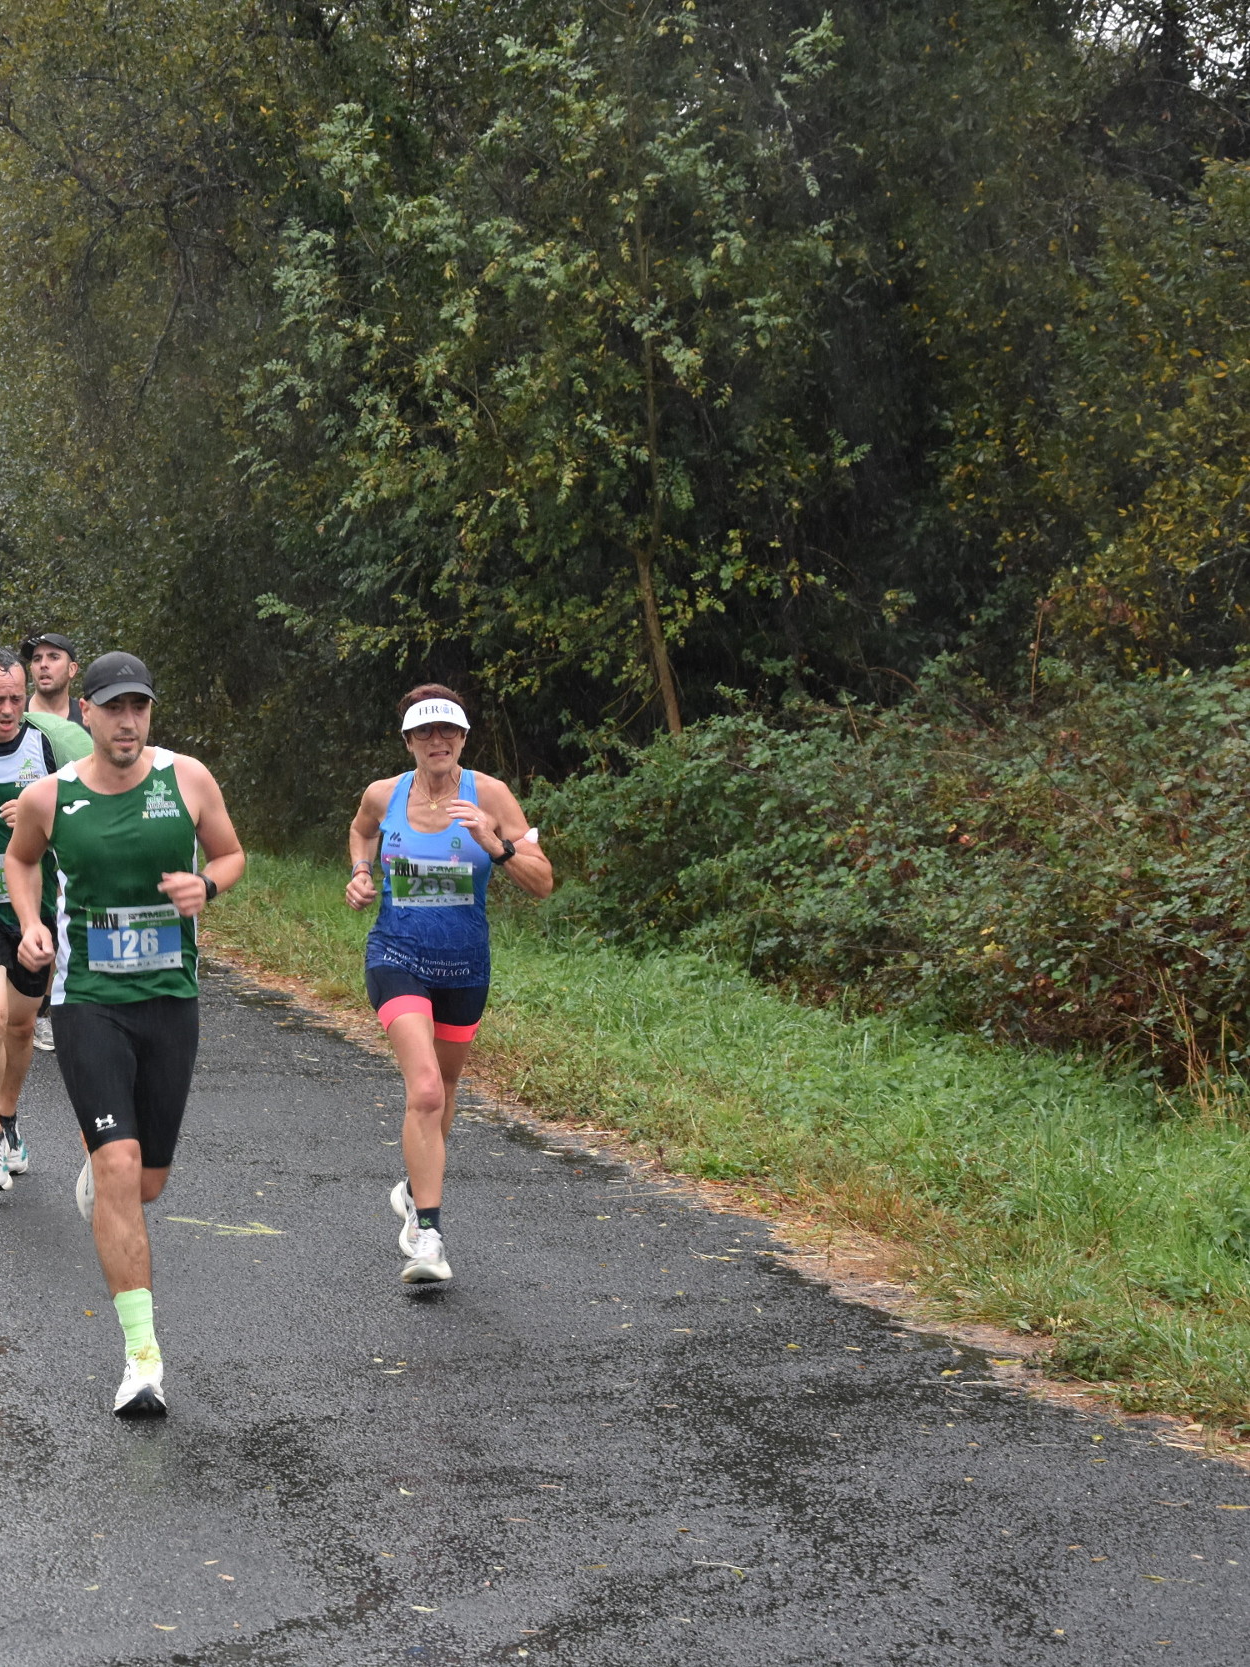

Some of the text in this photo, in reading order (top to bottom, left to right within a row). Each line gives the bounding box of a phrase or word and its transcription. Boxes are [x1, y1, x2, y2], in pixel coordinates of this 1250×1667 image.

[407, 877, 457, 895] 239
[108, 928, 159, 958] 126
[410, 963, 470, 977] SANTIAGO
